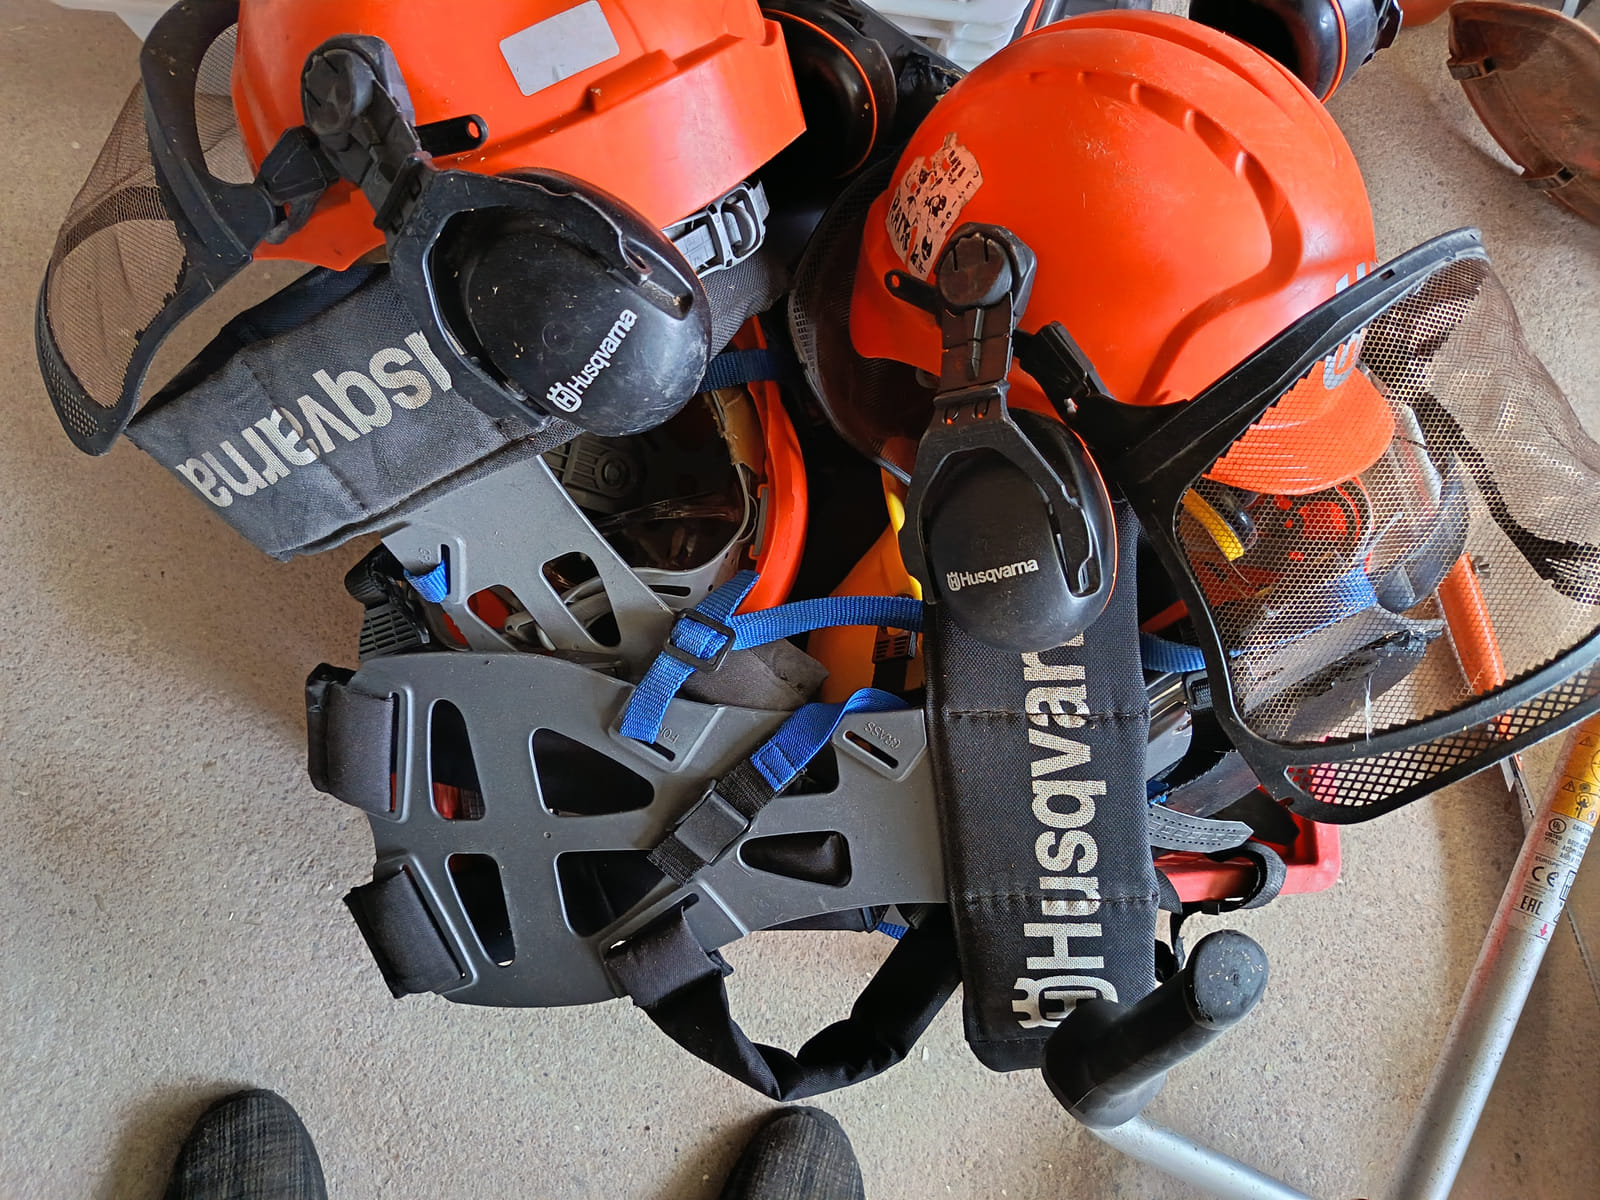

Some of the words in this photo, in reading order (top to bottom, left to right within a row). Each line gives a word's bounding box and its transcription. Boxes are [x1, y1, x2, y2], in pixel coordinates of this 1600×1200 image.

[566, 309, 638, 395] Husqvarna
[960, 559, 1039, 587] Husqvarna
[660, 723, 680, 745] FO
[864, 721, 902, 750] GRASS
[1021, 630, 1108, 970] Husqvar
[1531, 866, 1559, 887] CE
[1520, 895, 1543, 915] EAC
